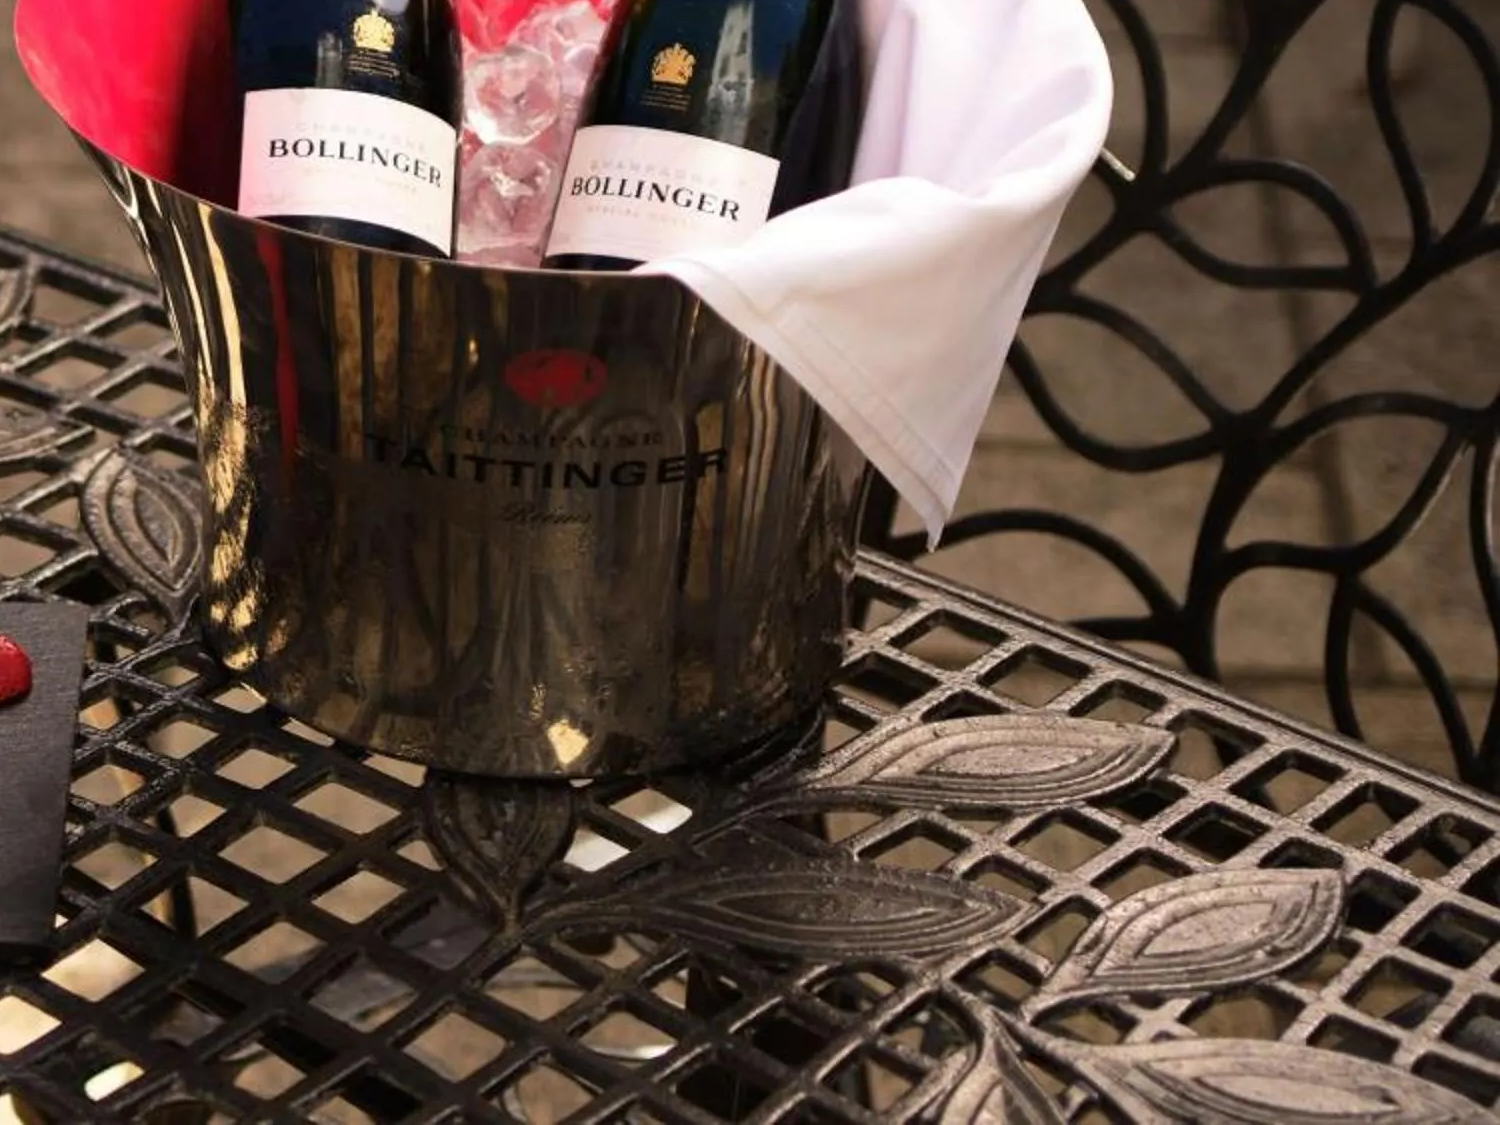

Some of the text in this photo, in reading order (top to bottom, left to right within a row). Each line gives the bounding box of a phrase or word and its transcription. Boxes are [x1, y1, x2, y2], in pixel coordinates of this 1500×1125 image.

[268, 137, 442, 188] BOLLINGER
[571, 174, 740, 222] BOLLINGER
[365, 432, 728, 489] TAITTINGER
[439, 424, 664, 449] CHAMPAGNE
